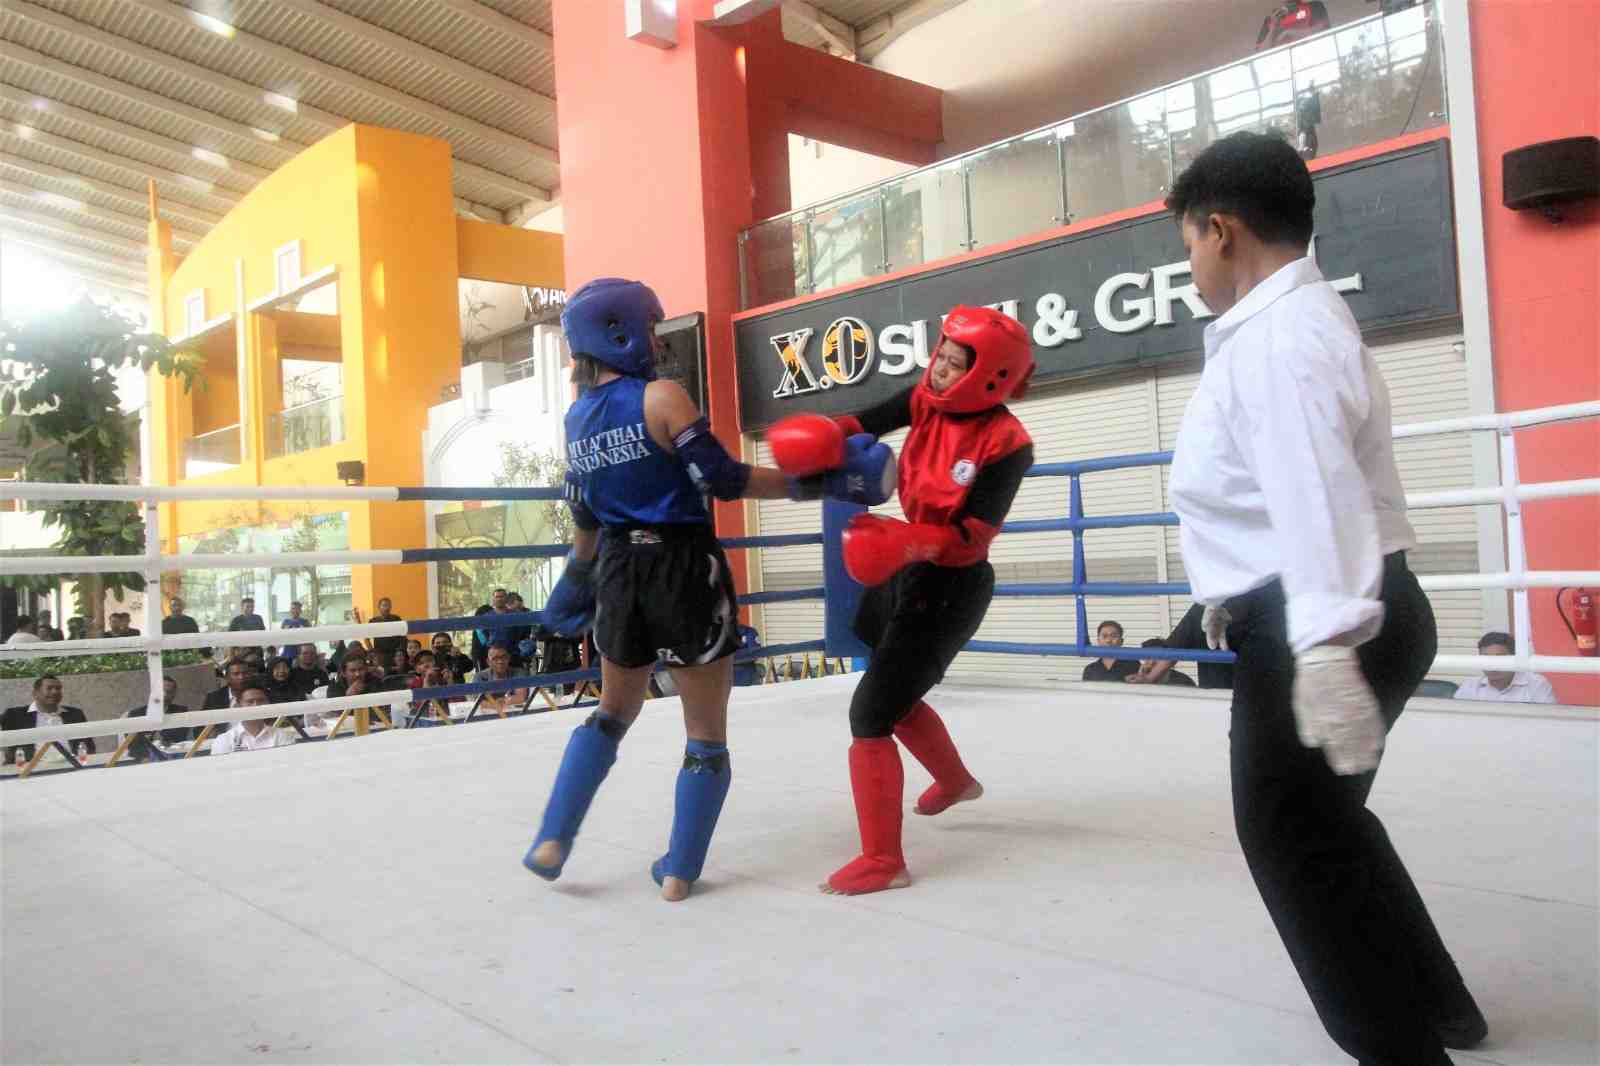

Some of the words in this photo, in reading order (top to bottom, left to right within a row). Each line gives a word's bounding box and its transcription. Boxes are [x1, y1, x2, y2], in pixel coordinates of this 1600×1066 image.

[769, 316, 875, 398] X.O
[1032, 293, 1083, 347] &
[567, 434, 602, 458] MUAY
[601, 422, 646, 449] THAI
